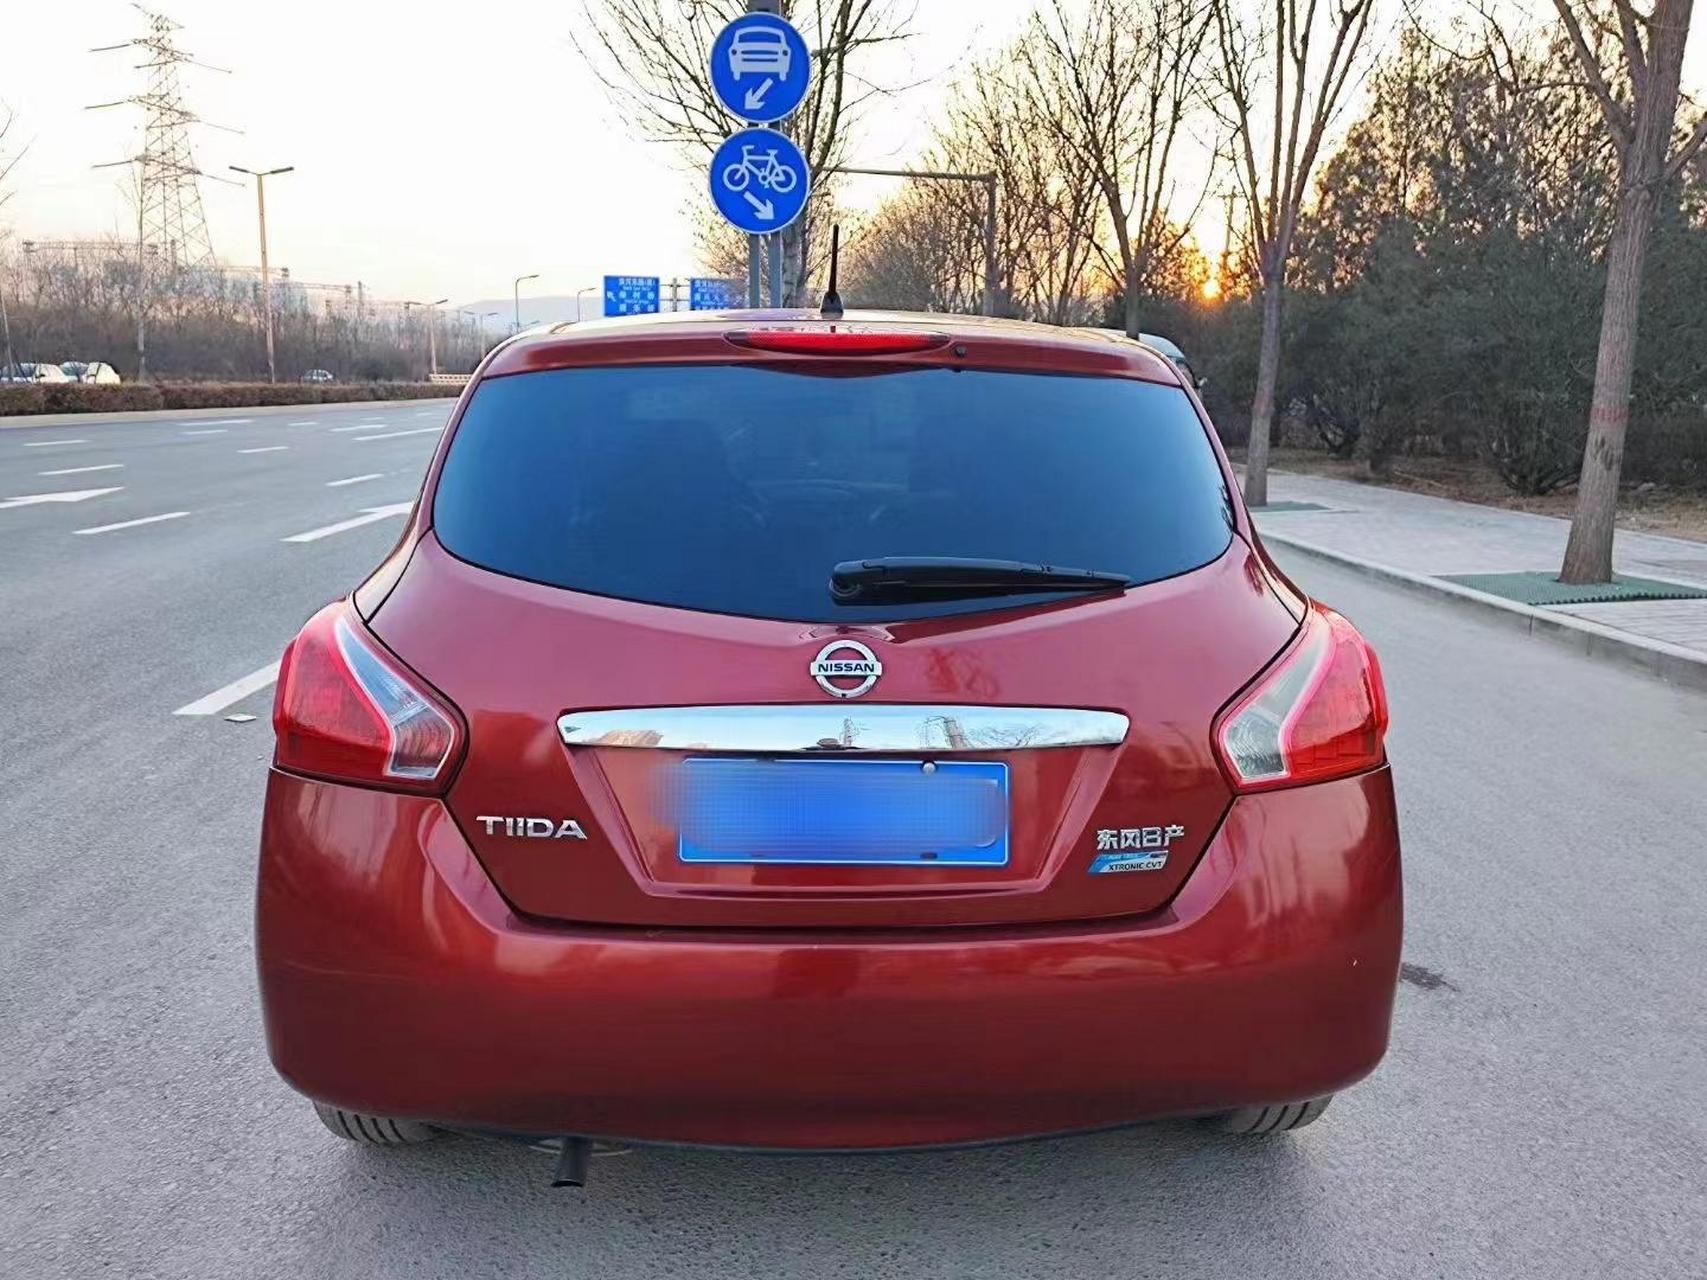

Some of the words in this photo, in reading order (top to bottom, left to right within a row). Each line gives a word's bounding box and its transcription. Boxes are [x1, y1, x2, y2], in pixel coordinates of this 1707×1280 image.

[818, 663, 875, 673] NISSAN
[476, 815, 588, 841] TIIDA
[1096, 824, 1185, 850] 东风日产
[1108, 863, 1145, 871] XTRONIC
[1145, 861, 1163, 869] CVT
